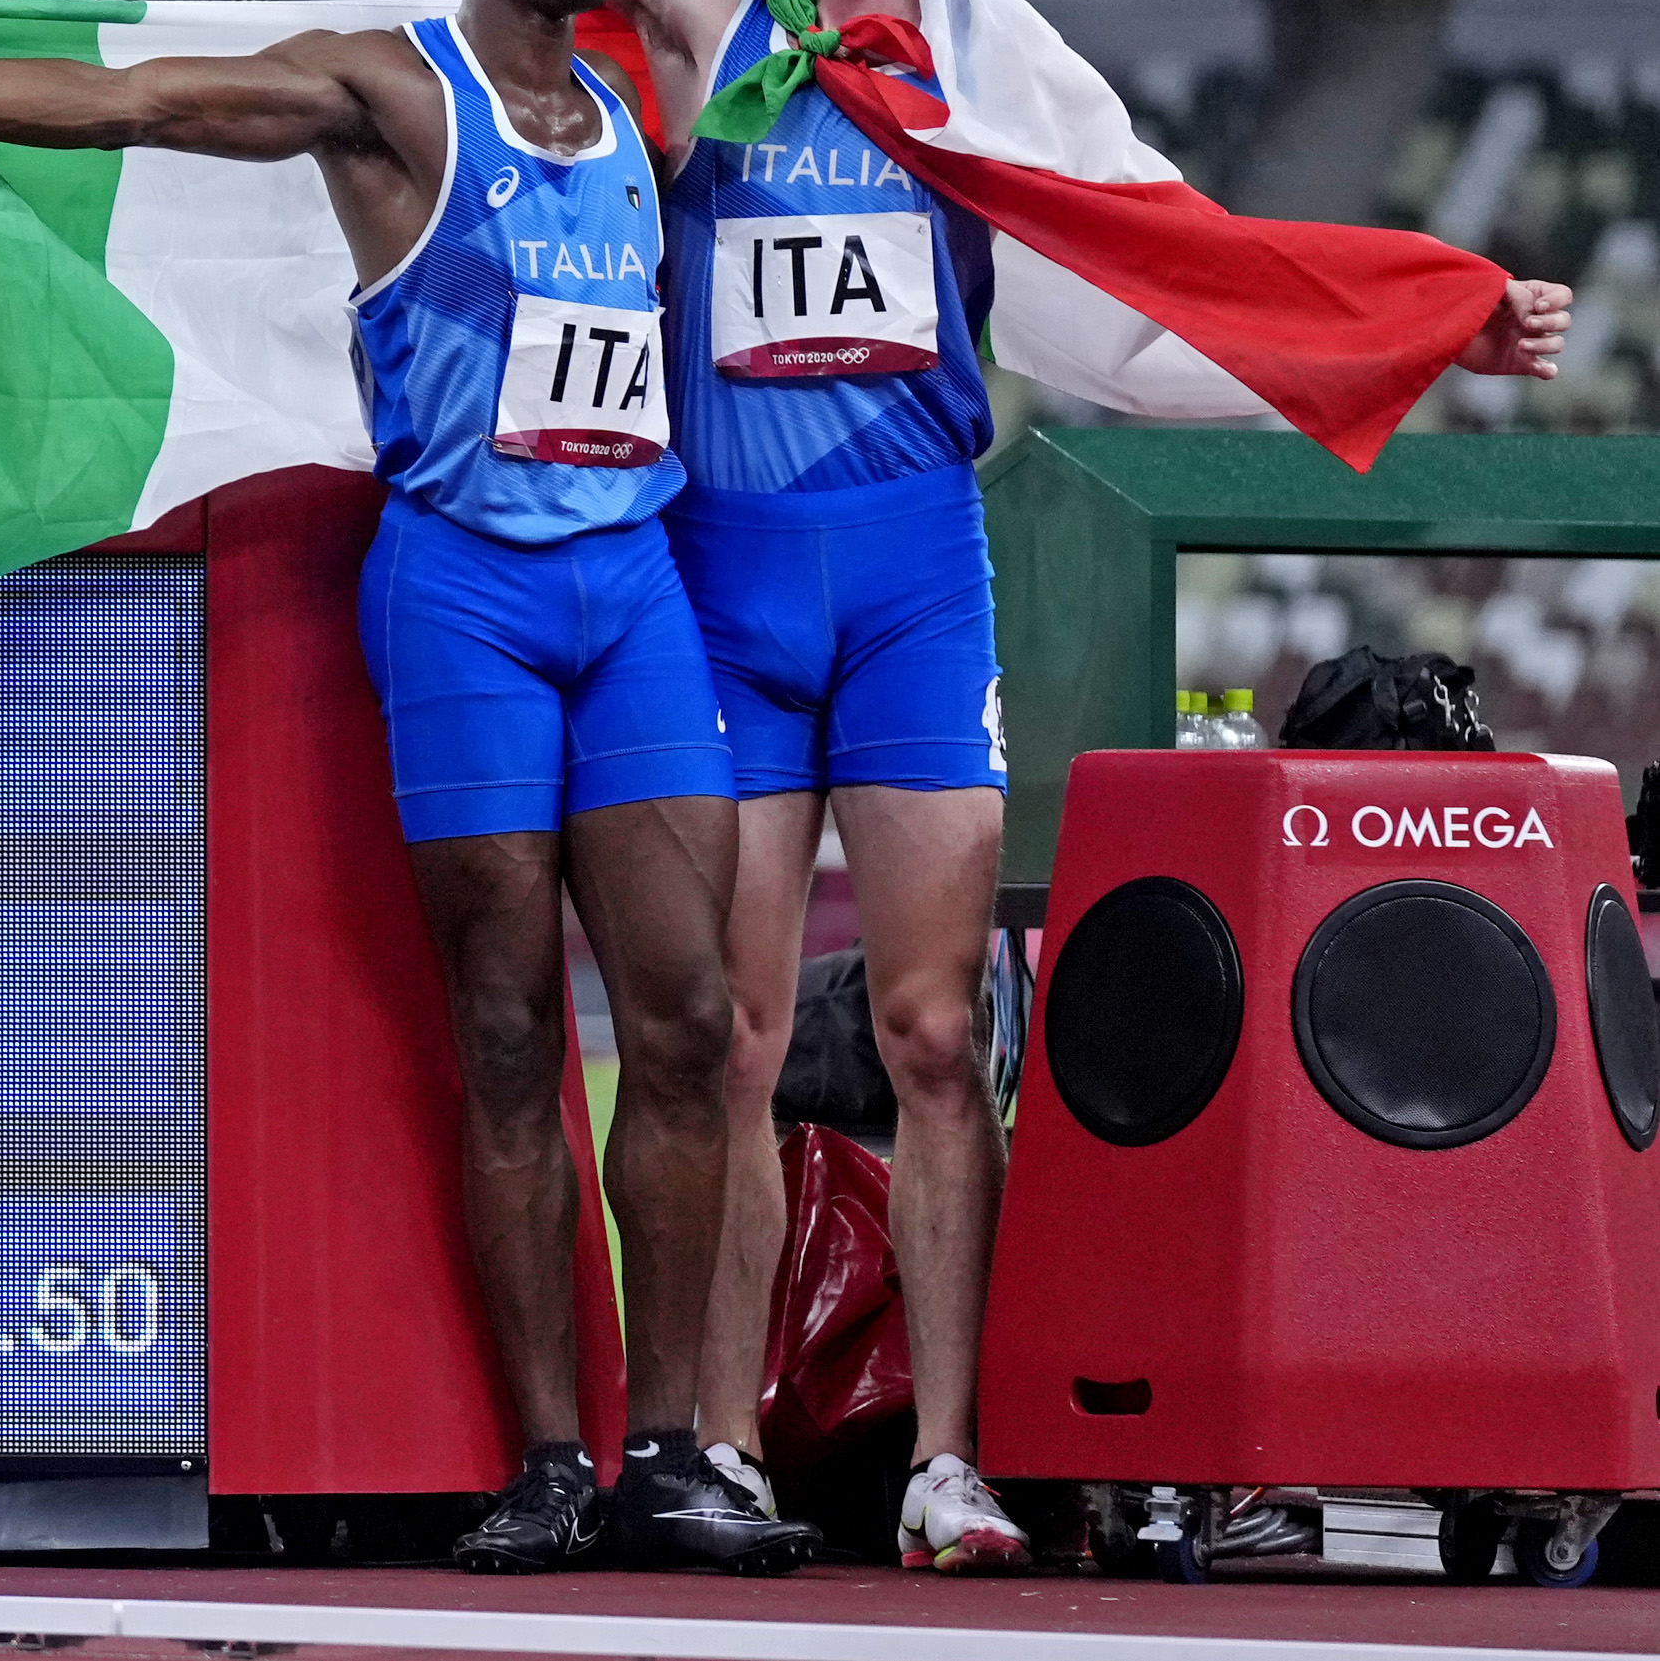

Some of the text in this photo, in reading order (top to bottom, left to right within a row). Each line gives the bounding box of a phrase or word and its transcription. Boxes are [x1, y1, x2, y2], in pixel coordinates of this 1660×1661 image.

[742, 143, 912, 191] ITALIA
[511, 239, 646, 281] ITALIA
[753, 234, 887, 318] ITA
[550, 323, 650, 411] ITA
[772, 351, 834, 365] TOKYO 2020
[561, 440, 610, 455] TOKYO 2020
[1351, 805, 1555, 850] OMEGA
